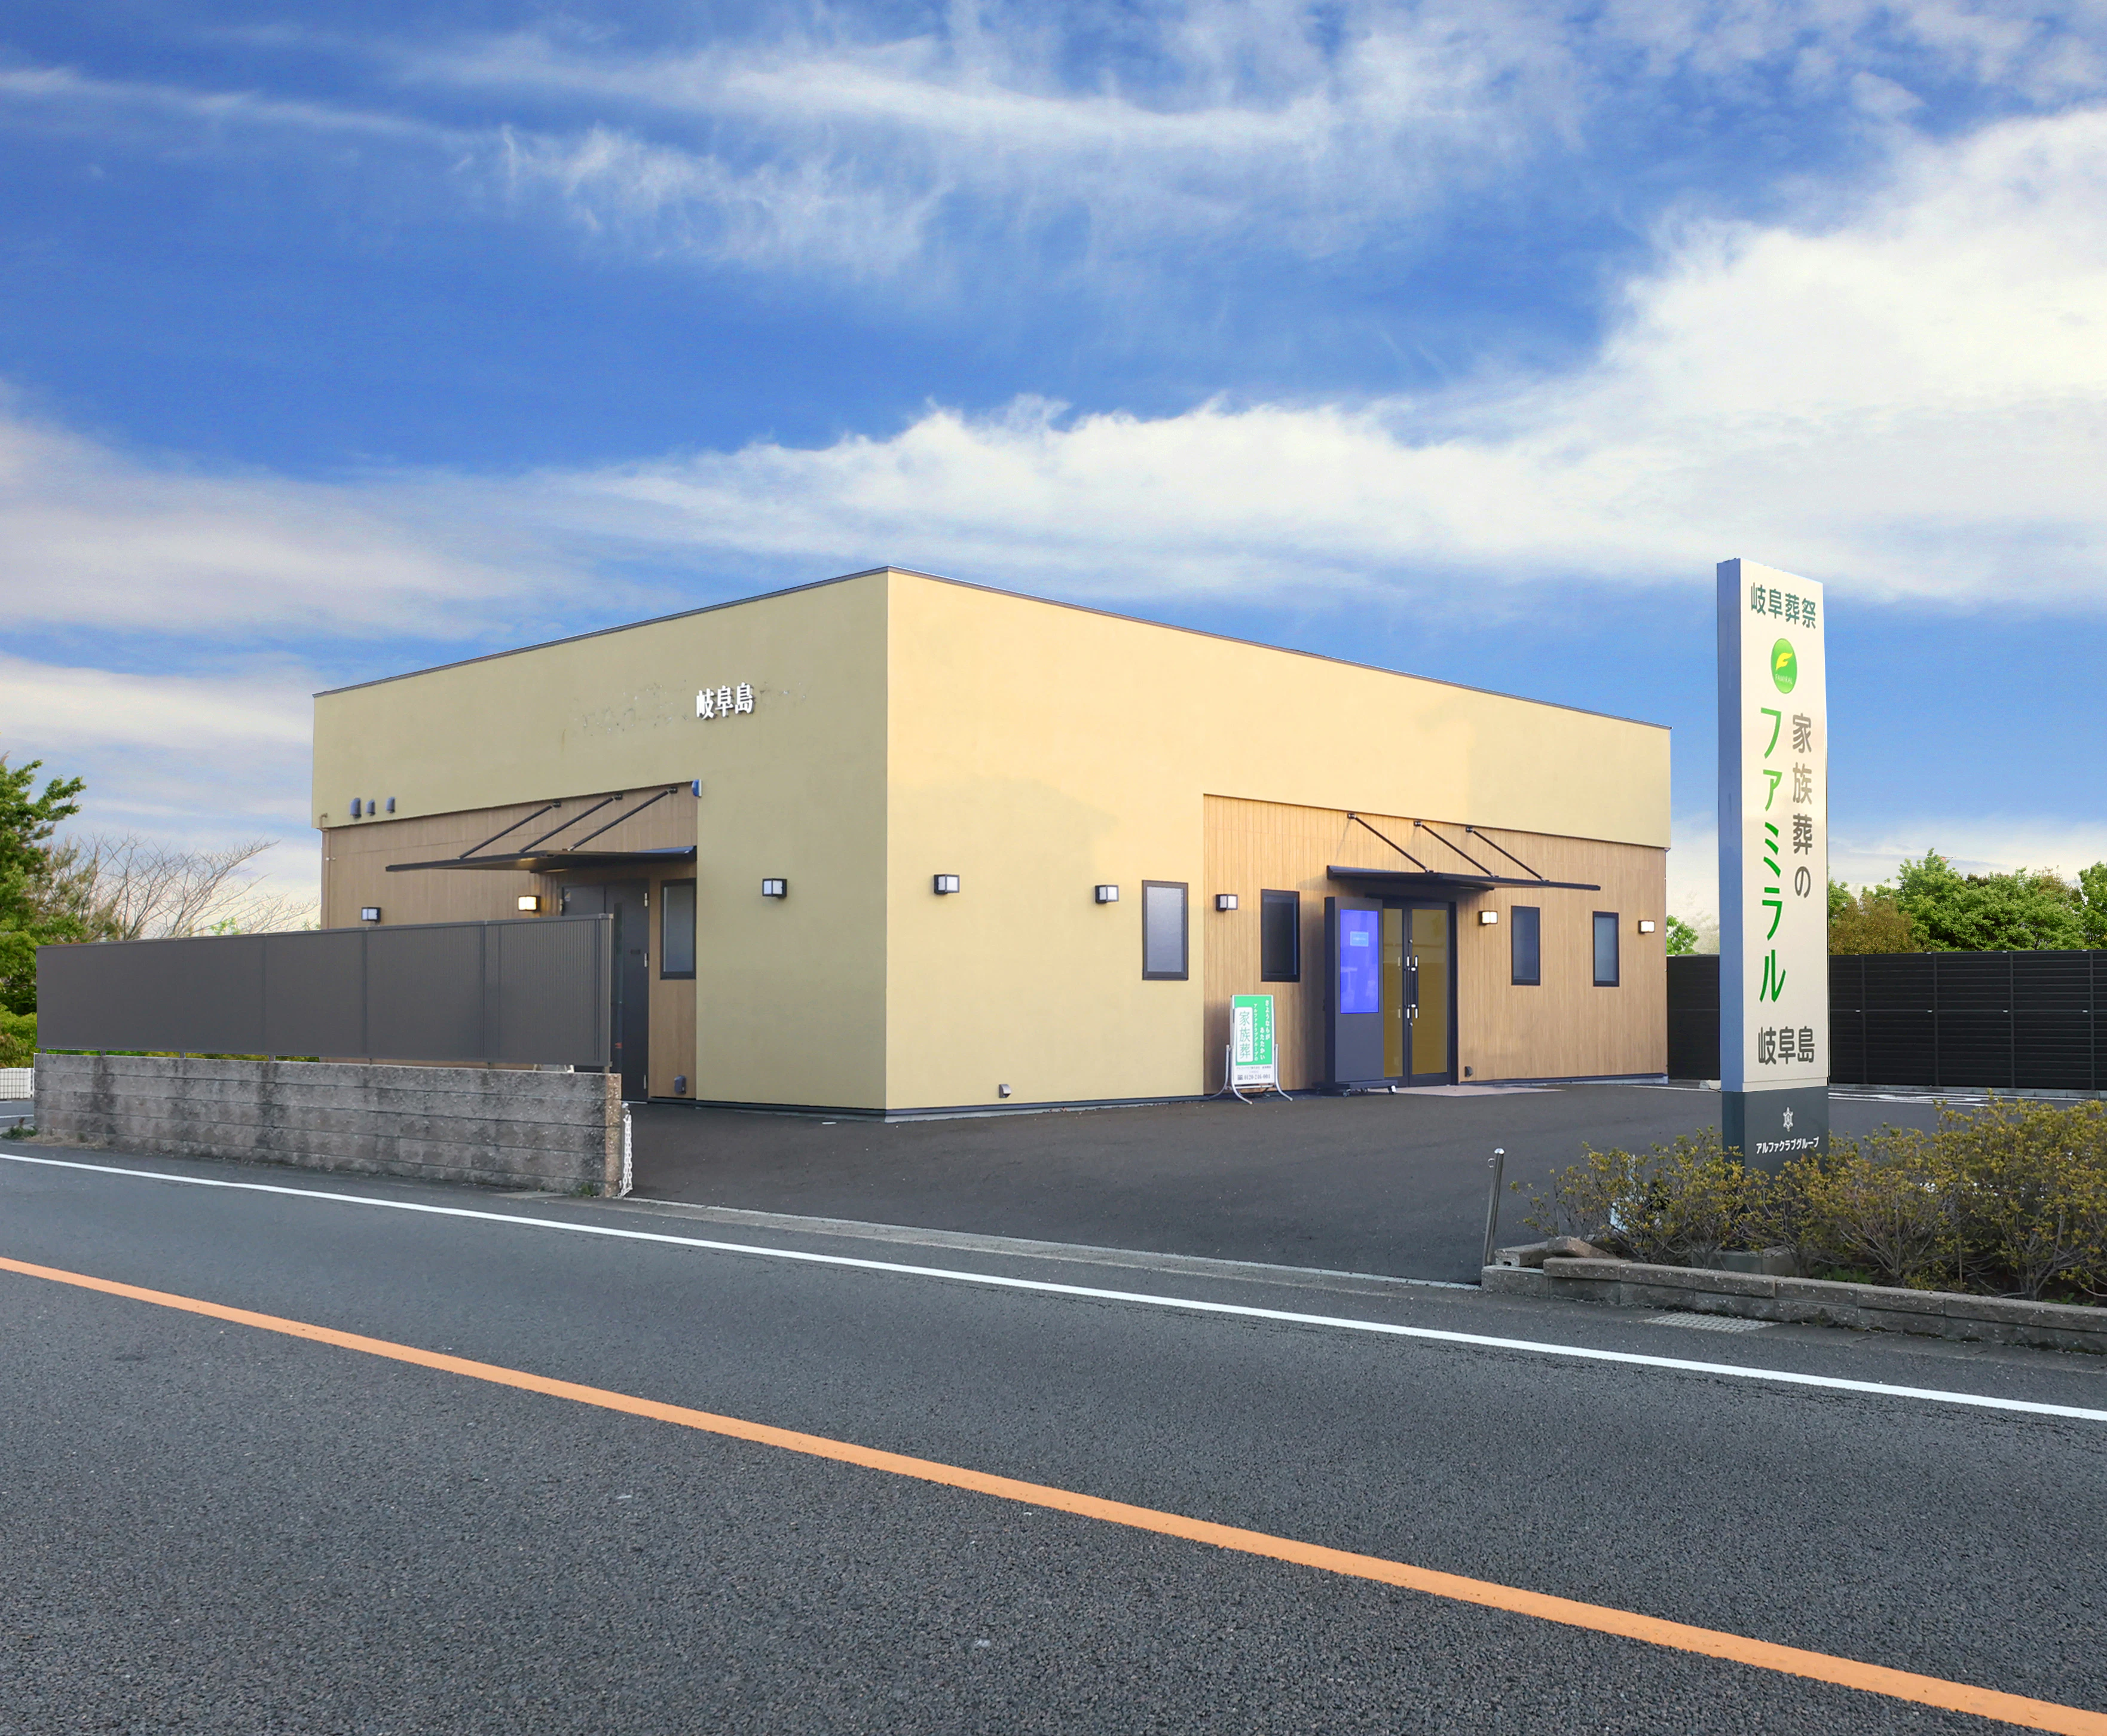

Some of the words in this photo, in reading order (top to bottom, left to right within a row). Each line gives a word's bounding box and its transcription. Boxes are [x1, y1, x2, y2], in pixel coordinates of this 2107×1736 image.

[1751, 582, 1816, 629] 岐阜葬祭
[696, 682, 753, 720] 岐阜島
[1793, 713, 1812, 898] 家族葬の
[1759, 708, 1786, 1002] ファミラル
[1239, 1011, 1250, 1059] 家族葬
[1758, 1026, 1815, 1065] 岐阜島
[1756, 1136, 1819, 1154] アルファクラブグループ
